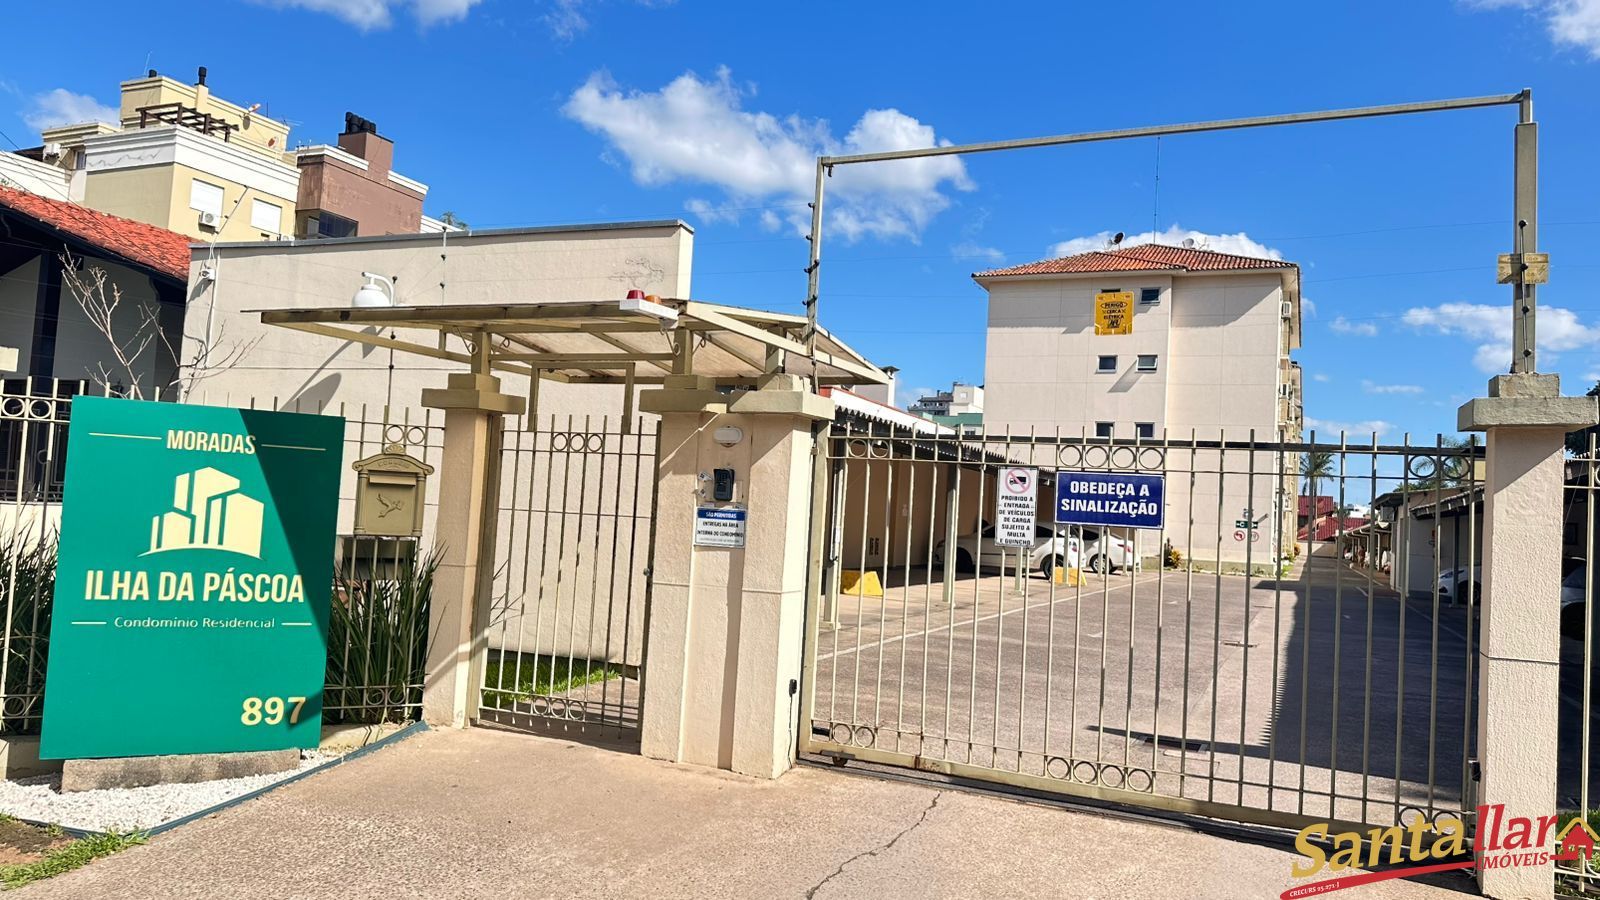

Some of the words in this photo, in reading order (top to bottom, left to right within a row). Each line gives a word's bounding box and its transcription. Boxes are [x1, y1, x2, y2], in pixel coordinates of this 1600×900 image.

[166, 429, 256, 455] MORADAS
[1070, 481, 1135, 499] OBEDEÇA
[1139, 484, 1150, 497] A
[1061, 498, 1158, 517] SINALIZAÇÃO
[1004, 538, 1031, 546] GUINCHO
[84, 569, 150, 600] ILHA
[157, 571, 195, 601] DA
[202, 567, 305, 603] PÁSCOA
[202, 617, 275, 629] Residencial
[240, 696, 306, 726] 897
